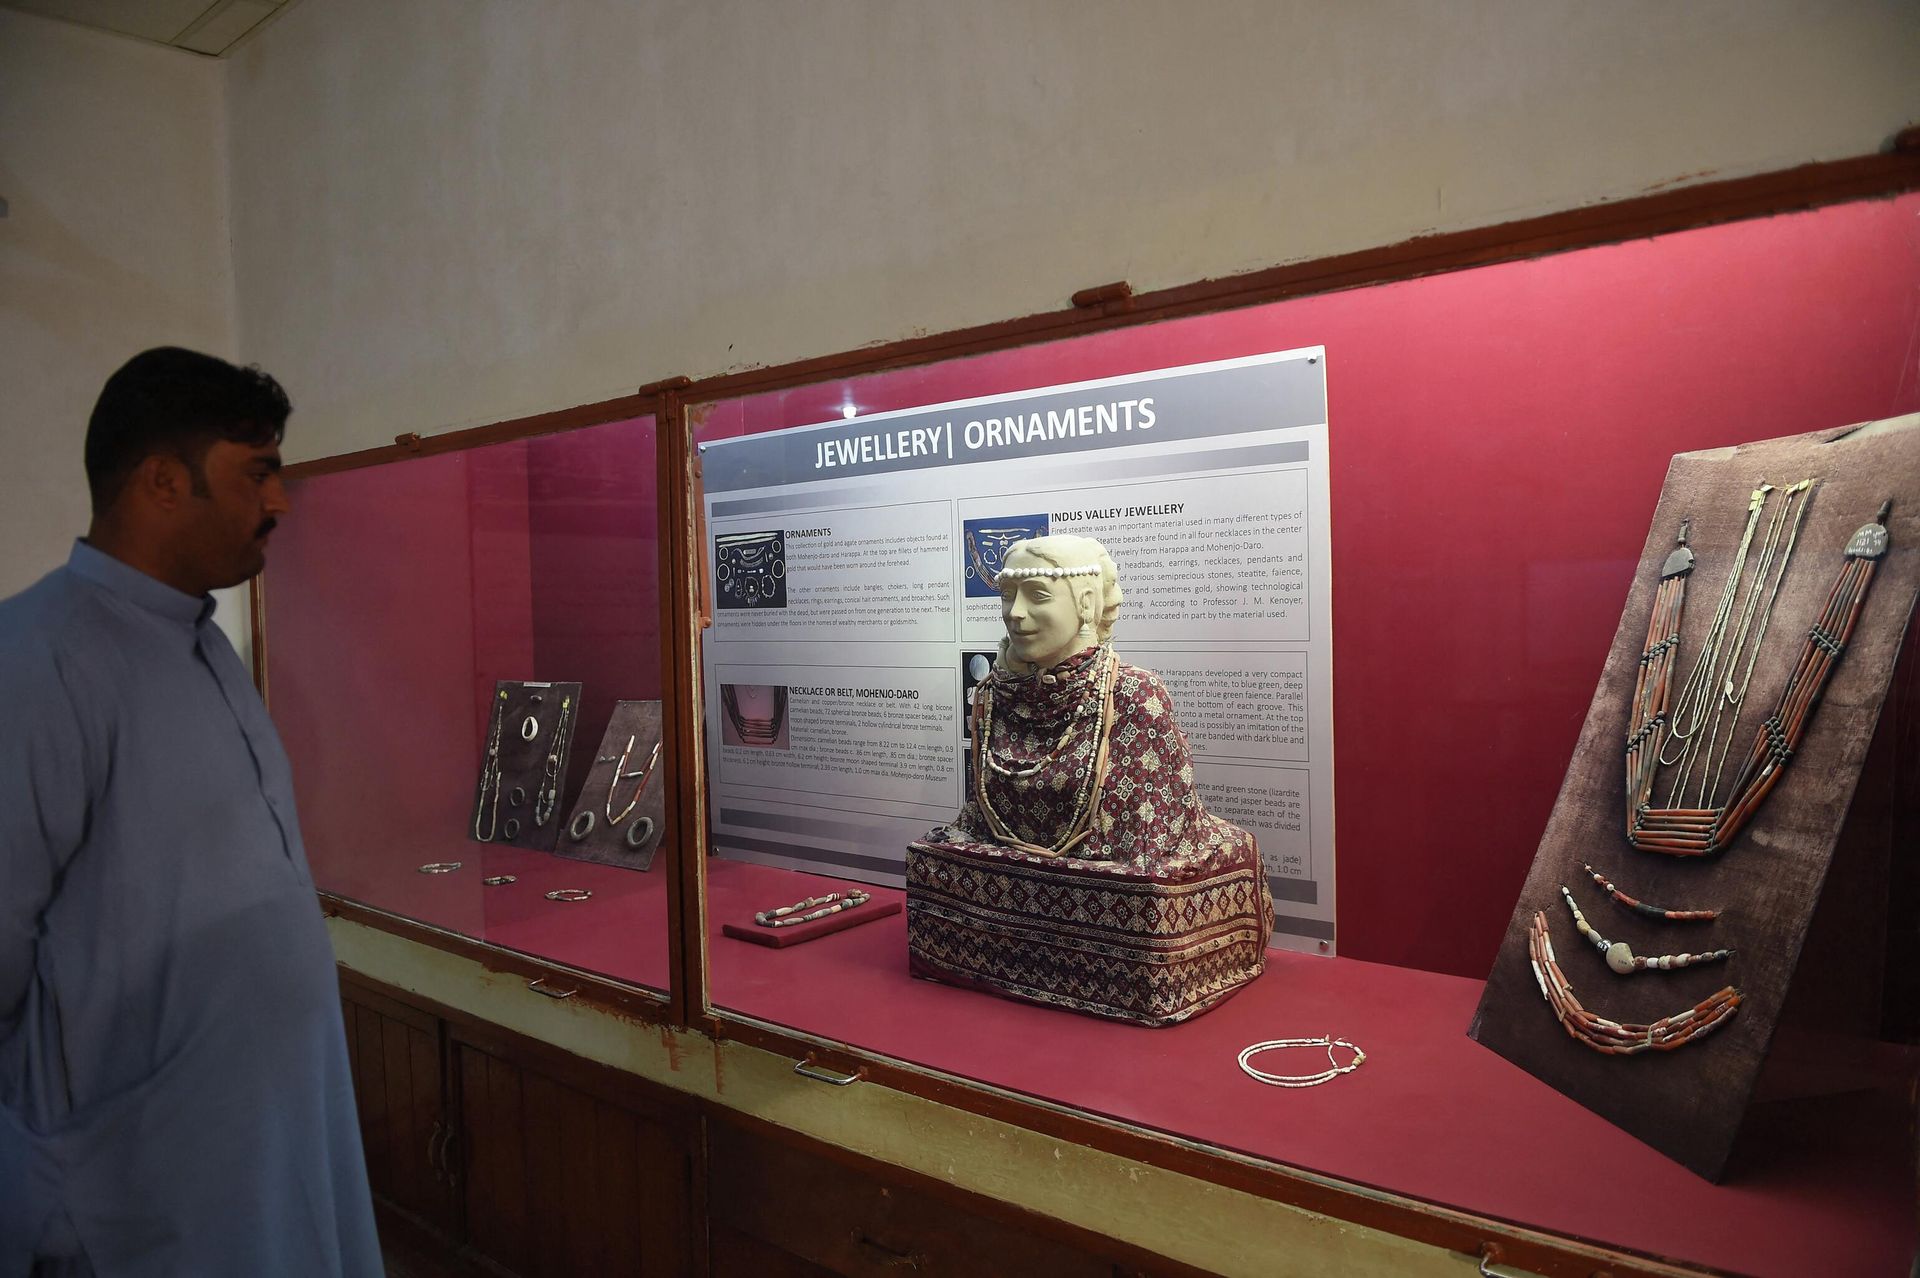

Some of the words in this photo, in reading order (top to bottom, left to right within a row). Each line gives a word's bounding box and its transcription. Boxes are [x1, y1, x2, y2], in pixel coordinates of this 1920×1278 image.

[963, 397, 1156, 450] ORNAMENTS
[1051, 511, 1083, 522] INDUS
[1085, 508, 1122, 520] VALLEY
[1124, 503, 1185, 517] JEWELLERY
[1051, 526, 1067, 535] Fired
[1068, 525, 1093, 534] steatite
[1118, 521, 1153, 532] important
[1154, 519, 1184, 528] material
[1185, 517, 1203, 527] used
[1204, 517, 1212, 525] in
[1213, 517, 1234, 526] many
[1235, 513, 1269, 523] different
[1270, 513, 1292, 523] types
[1293, 511, 1303, 520] of
[785, 527, 832, 539] ORNAMENTS
[1122, 534, 1144, 543] beads
[1157, 532, 1178, 541] found
[1179, 532, 1187, 540] in
[1188, 531, 1197, 539] all
[1198, 531, 1214, 539] four
[1215, 529, 1252, 538] necklaces
[1253, 528, 1261, 536] in
[1262, 527, 1275, 535] the
[1277, 526, 1303, 535] center
[1114, 548, 1140, 558] jewelry
[1140, 547, 1158, 555] from
[1159, 546, 1189, 555] Harappa
[1190, 544, 1205, 553] and
[1206, 542, 1264, 553] Mohenjo-Daro.
[1124, 560, 1165, 569] headbands,
[1168, 558, 1200, 568] earrings,
[1204, 557, 1243, 566] necklaces,
[1247, 555, 1284, 566] pendants
[1288, 553, 1303, 562] and
[1119, 574, 1128, 582] of
[1129, 573, 1155, 581] various
[1157, 571, 1205, 582] semiprecious
[1208, 571, 1235, 579] stones,
[1237, 569, 1269, 578] steatite,
[1272, 568, 1303, 577] faience,
[1136, 586, 1149, 594] and
[1152, 586, 1192, 594] sometimes
[1194, 585, 1213, 595] gold,
[1216, 584, 1248, 594] showing
[1251, 582, 1303, 593] technological
[966, 603, 1002, 612] sophisticatio
[1150, 599, 1185, 608] According
[1203, 598, 1237, 606] Professor
[1242, 597, 1248, 605] J.
[1253, 597, 1265, 605] M.
[1270, 597, 1303, 607] Kenoyer,
[1131, 612, 1147, 620] rank
[1148, 612, 1181, 620] indicated
[1182, 612, 1189, 620] in
[1190, 612, 1207, 621] part
[1207, 612, 1217, 621] by
[1218, 611, 1232, 619] the
[1233, 611, 1265, 619] material
[1266, 611, 1288, 619] used.
[1166, 669, 1203, 678] Harappans
[1205, 670, 1243, 679] developed
[1271, 672, 1303, 680] compact
[1208, 680, 1231, 688] white,
[1283, 682, 1303, 691] deep
[789, 686, 824, 696] NECKLACE
[825, 687, 836, 696] OR
[837, 688, 855, 697] BELT,
[855, 688, 920, 700] MOHENJO-DARO
[1245, 692, 1274, 700] faience.
[1276, 693, 1304, 701] Parallel
[1197, 701, 1224, 709] bottom
[1290, 715, 1304, 724] top
[1206, 722, 1236, 731] possibly
[1247, 723, 1281, 731] imitation
[1207, 732, 1235, 740] banded
[1211, 784, 1225, 792] and
[1226, 786, 1246, 794] green
[1247, 787, 1268, 796] stone
[1269, 788, 1300, 798] (lizardite
[1205, 795, 1223, 803] agate
[1240, 797, 1263, 807] jasper
[1264, 799, 1286, 808] beads
[1214, 805, 1222, 813] to
[1224, 807, 1255, 816] separate
[1257, 810, 1275, 818] each
[1277, 811, 1286, 819] of
[1288, 812, 1301, 820] the
[1236, 818, 1257, 827] which
[1258, 821, 1273, 829] was
[1274, 821, 1301, 831] divided
[1282, 855, 1302, 866] jade)
